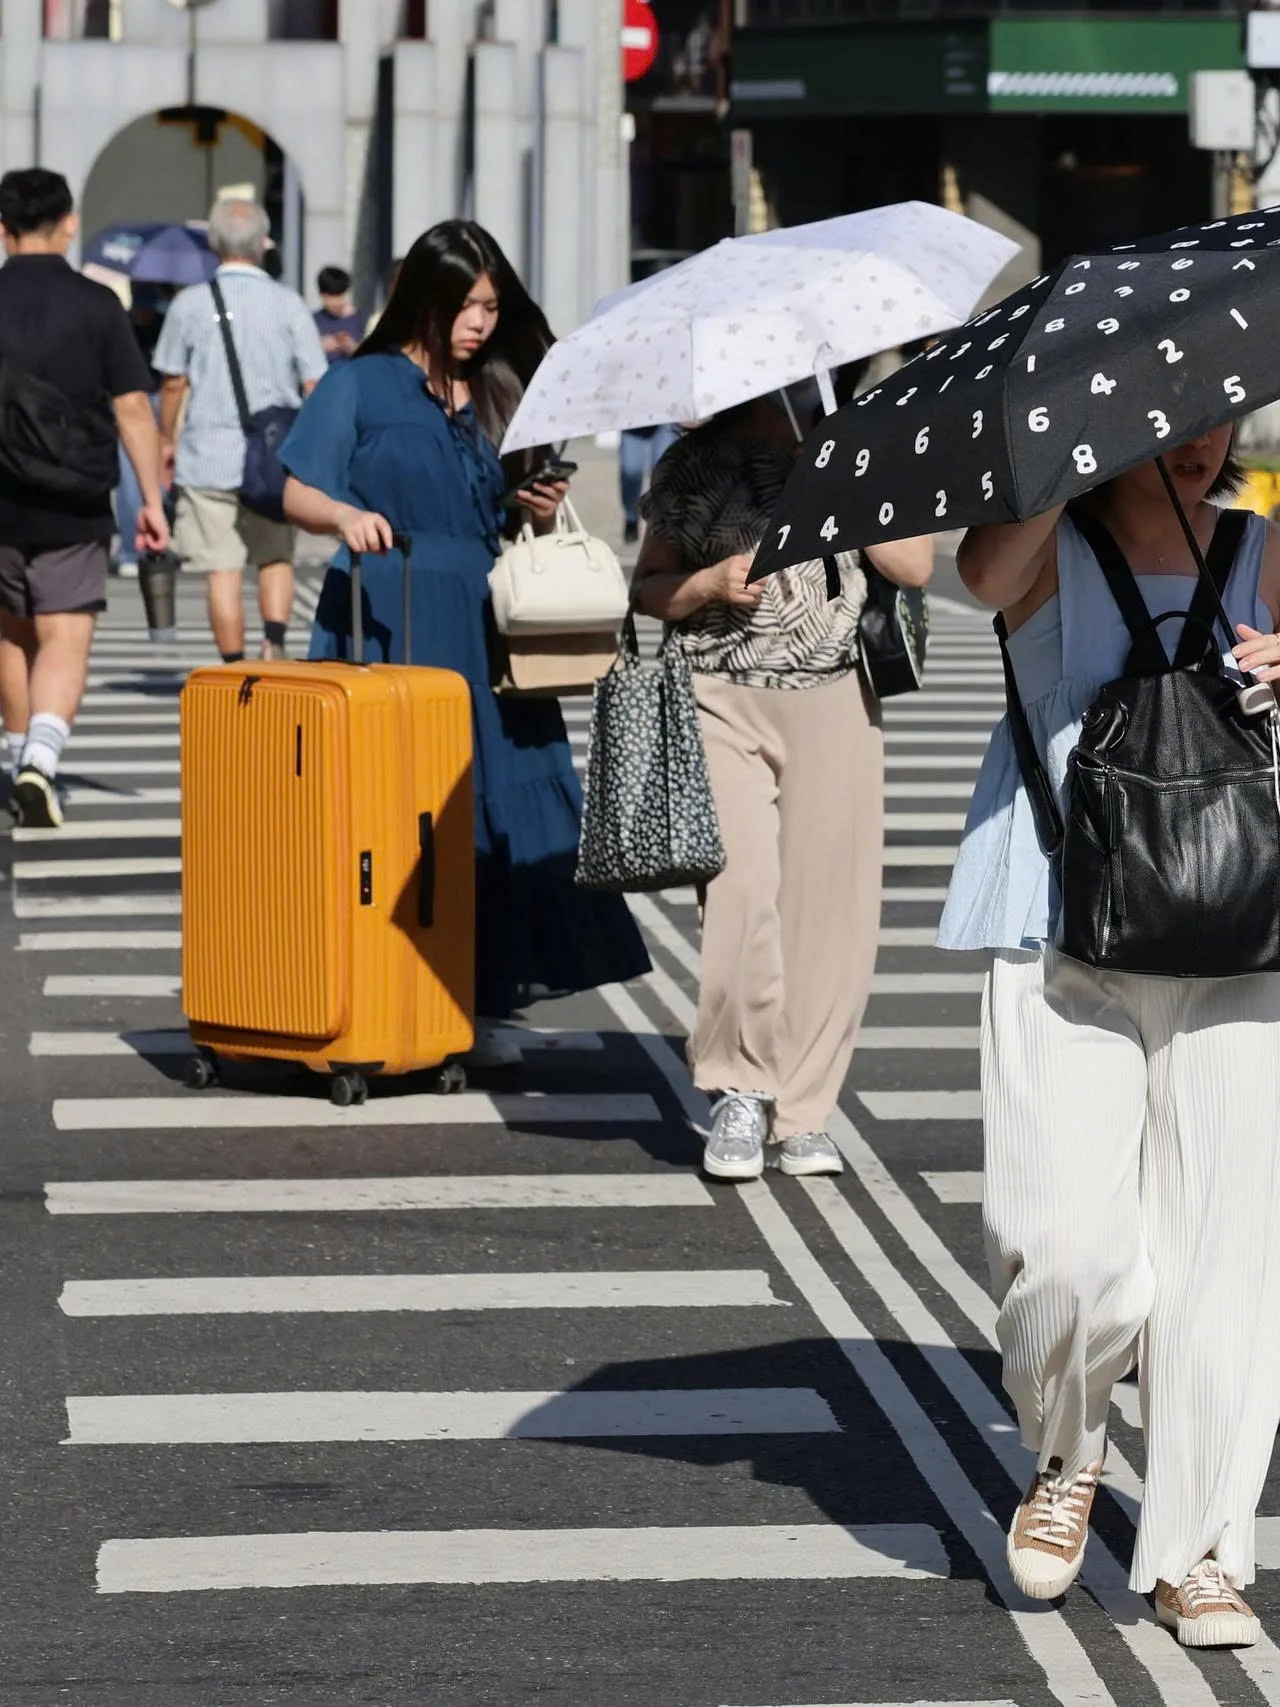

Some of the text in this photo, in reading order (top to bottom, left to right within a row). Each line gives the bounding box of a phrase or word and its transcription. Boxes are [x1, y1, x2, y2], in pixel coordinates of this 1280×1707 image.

[1065, 282, 1086, 295] 0
[1169, 288, 1190, 302] 0
[1045, 318, 1064, 332] 8
[1097, 318, 1119, 334] 9
[1230, 308, 1248, 330] 1
[988, 333, 1010, 350] 6
[1158, 339, 1184, 363] 2
[974, 365, 993, 379] 0
[1027, 355, 1036, 373] 1
[896, 387, 917, 405] 2
[939, 376, 954, 393] 1
[1091, 373, 1116, 395] 4
[1223, 375, 1246, 403] 5
[972, 410, 984, 438] 3
[1028, 407, 1049, 432] 6
[1148, 410, 1170, 438] 3
[915, 427, 929, 454] 6
[815, 440, 835, 468] 8
[855, 449, 870, 476] 9
[1072, 444, 1098, 474] 8
[981, 471, 993, 500] 5
[879, 502, 894, 525] 0
[935, 490, 947, 517] 2
[778, 525, 790, 549] 7
[820, 516, 838, 541] 4
